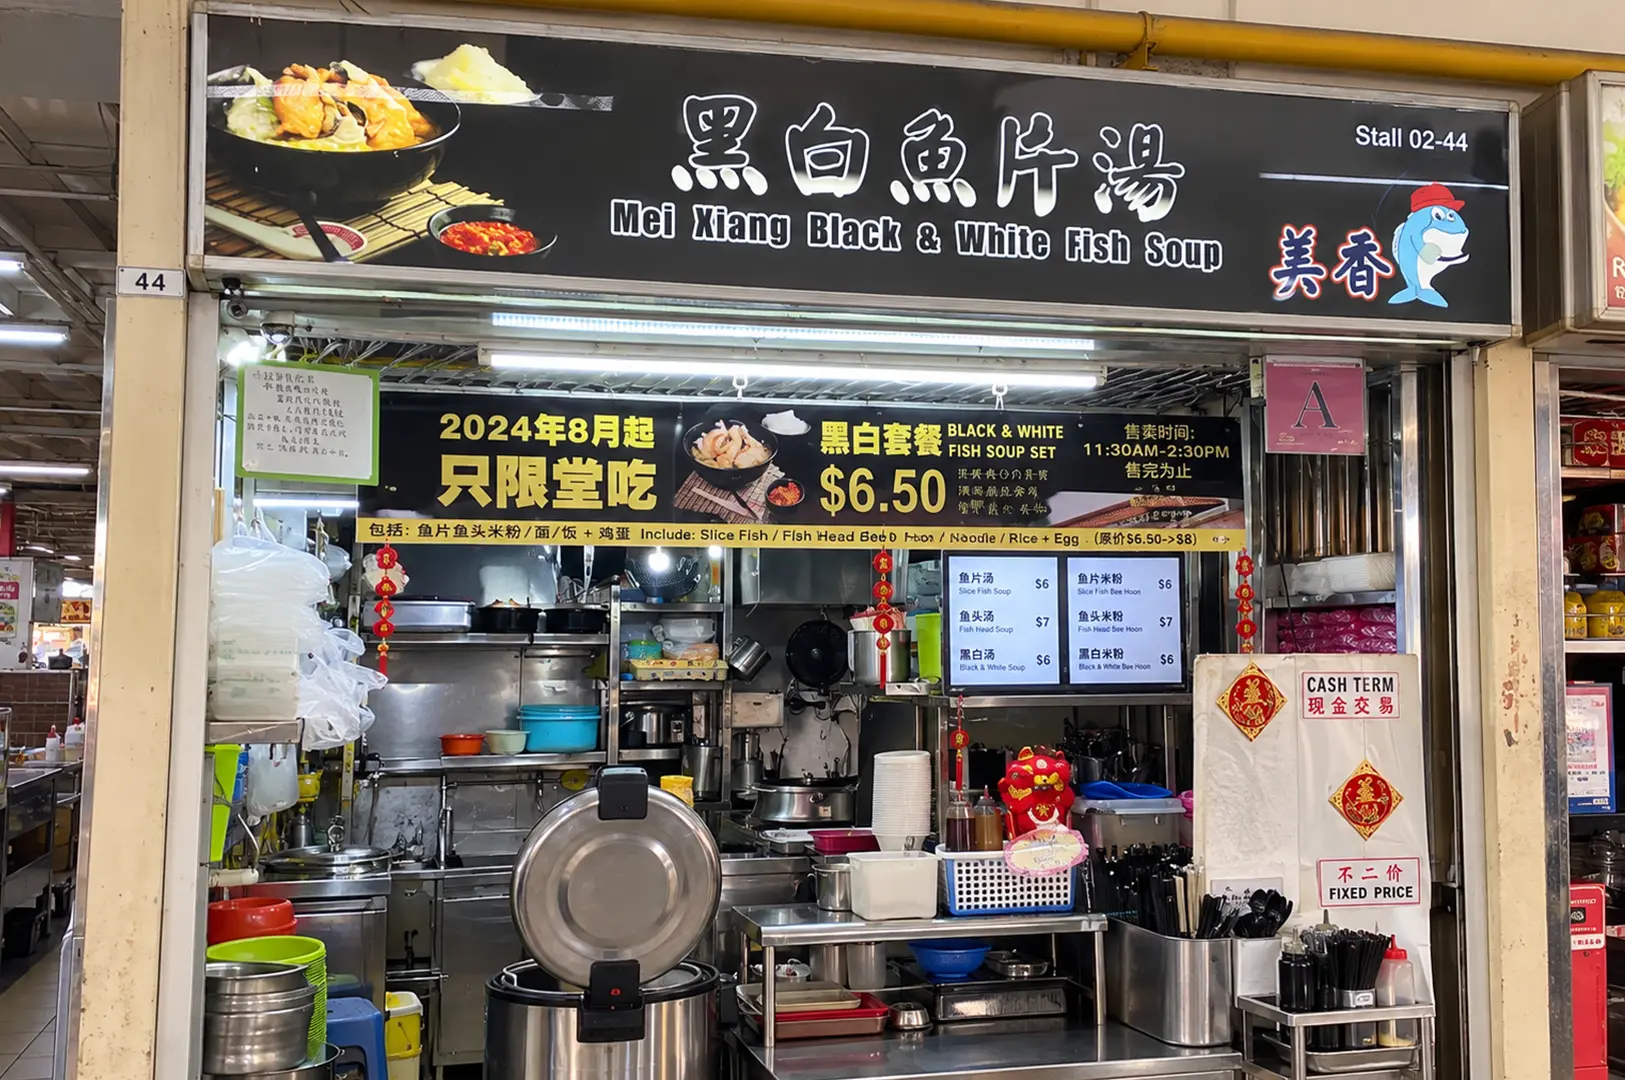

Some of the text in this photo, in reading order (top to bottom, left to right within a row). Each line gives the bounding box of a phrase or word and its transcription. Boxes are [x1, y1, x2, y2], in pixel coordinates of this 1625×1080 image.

[1355, 123, 1469, 152] Stall 02-44
[671, 94, 1185, 222] 黑白魚片湯
[610, 199, 1224, 272] Mei Xiang Black & White Fish Soup
[1268, 223, 1396, 302] 美香
[134, 271, 166, 292] 44
[1291, 380, 1340, 429] A
[440, 413, 655, 450] 2024年8月起
[820, 420, 943, 457] 黑白套餐
[948, 422, 1064, 440] BLACK & WHITE
[949, 444, 1056, 459] FISH SOUP SET
[1083, 442, 1230, 459] 11:30AM-2:30PM
[1124, 461, 1192, 479] 售完为止
[437, 454, 657, 511] 只限堂吃
[820, 463, 946, 517] $6.50
[641, 528, 696, 541] Include:
[700, 528, 735, 541] Slice
[739, 529, 768, 541] Fish
[817, 530, 854, 542] Head
[950, 532, 996, 544] Noodle
[1009, 533, 1038, 544] Rice
[1054, 532, 1080, 546] Egg
[959, 572, 1050, 590] 鱼片汤 $6
[1077, 572, 1173, 590] 鱼片米粉 $6
[959, 587, 1012, 597] Slice Fish Soup
[1077, 587, 1095, 596] Slice
[1124, 587, 1142, 596] Hoon
[959, 610, 1050, 628] 鱼头汤 $7
[1078, 610, 1173, 628] 鱼头米粉 $7
[959, 625, 1014, 635] Fish Head Soup
[1126, 625, 1143, 634] Hoon
[959, 648, 1051, 666] 黑白汤 $6
[1078, 647, 1174, 666] 黑白米粉 $6
[959, 663, 978, 672] Black
[987, 663, 1007, 672] White
[1008, 664, 1026, 673] Soup
[1307, 676, 1394, 693] CASH TERM
[1308, 696, 1394, 716] 现金交易
[1338, 863, 1404, 884] 不二价
[1329, 885, 1413, 900] FIXED PRICE
